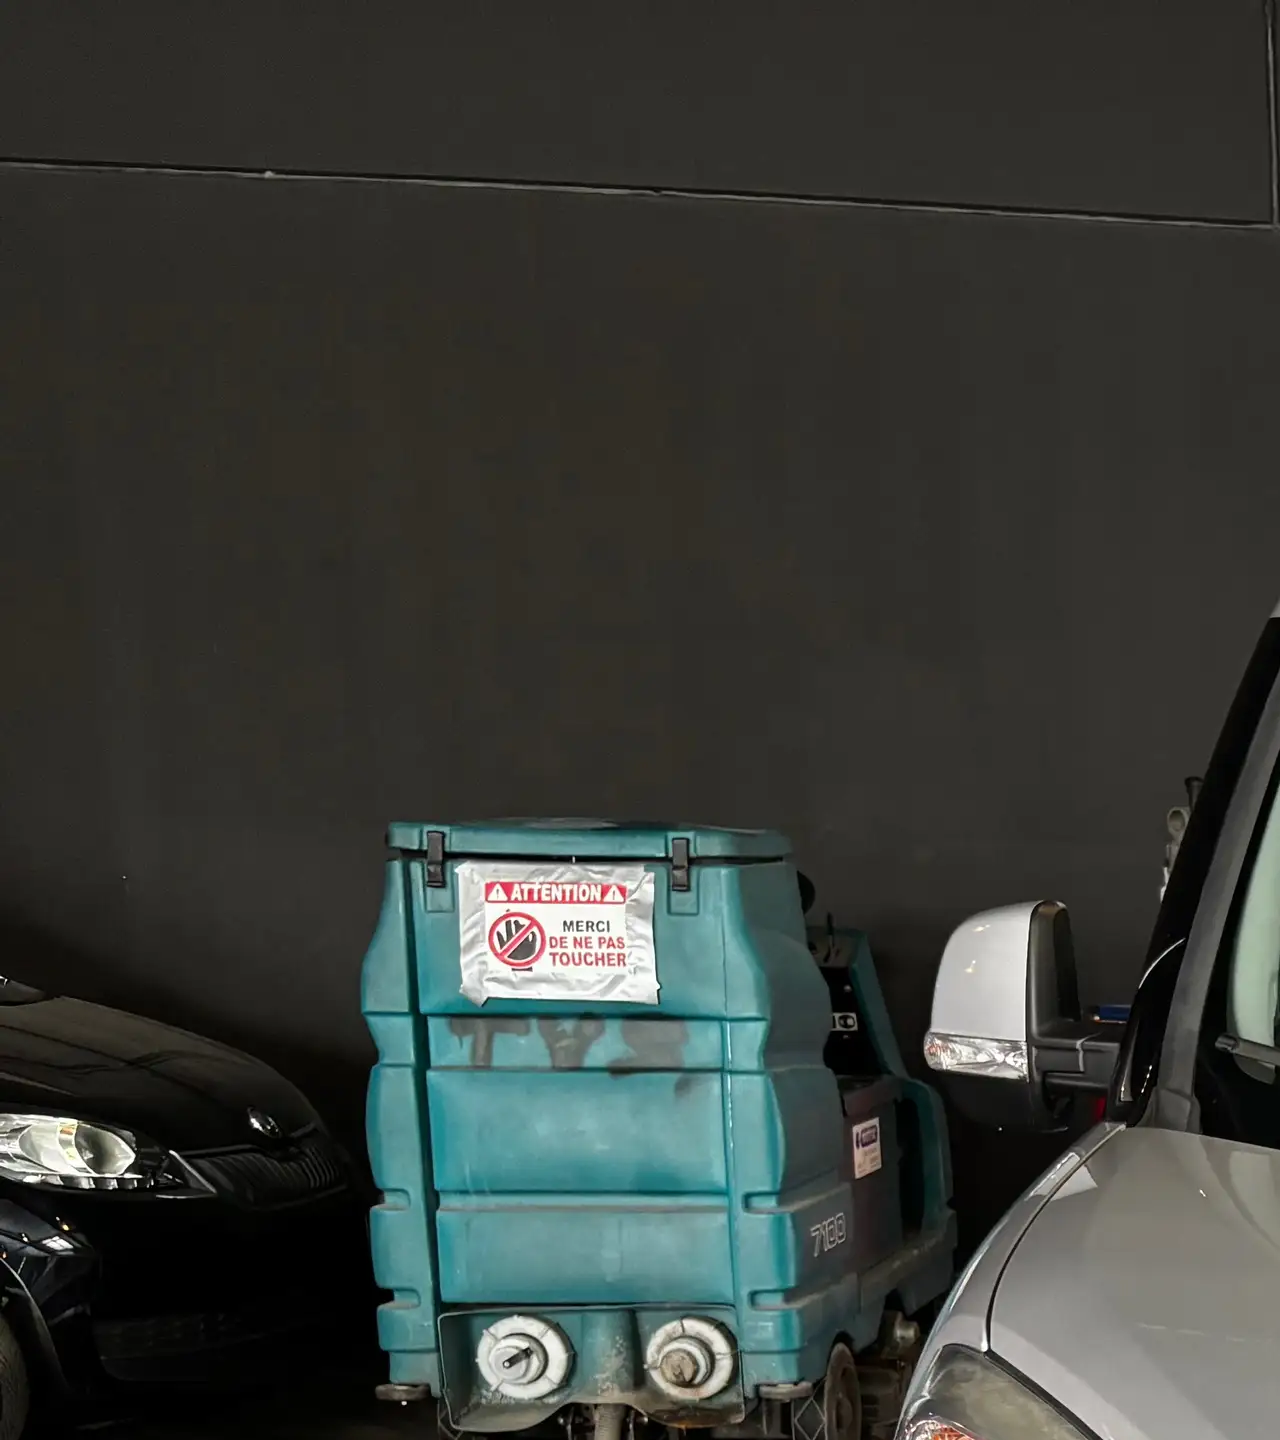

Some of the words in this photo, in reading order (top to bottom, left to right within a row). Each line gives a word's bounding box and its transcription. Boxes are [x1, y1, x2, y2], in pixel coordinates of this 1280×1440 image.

[511, 883, 602, 902] ATTENTION
[562, 920, 611, 933] MERCI
[549, 936, 570, 949] DE
[573, 936, 593, 949] NE
[598, 937, 626, 950] PAS
[549, 952, 627, 967] TOUCHER
